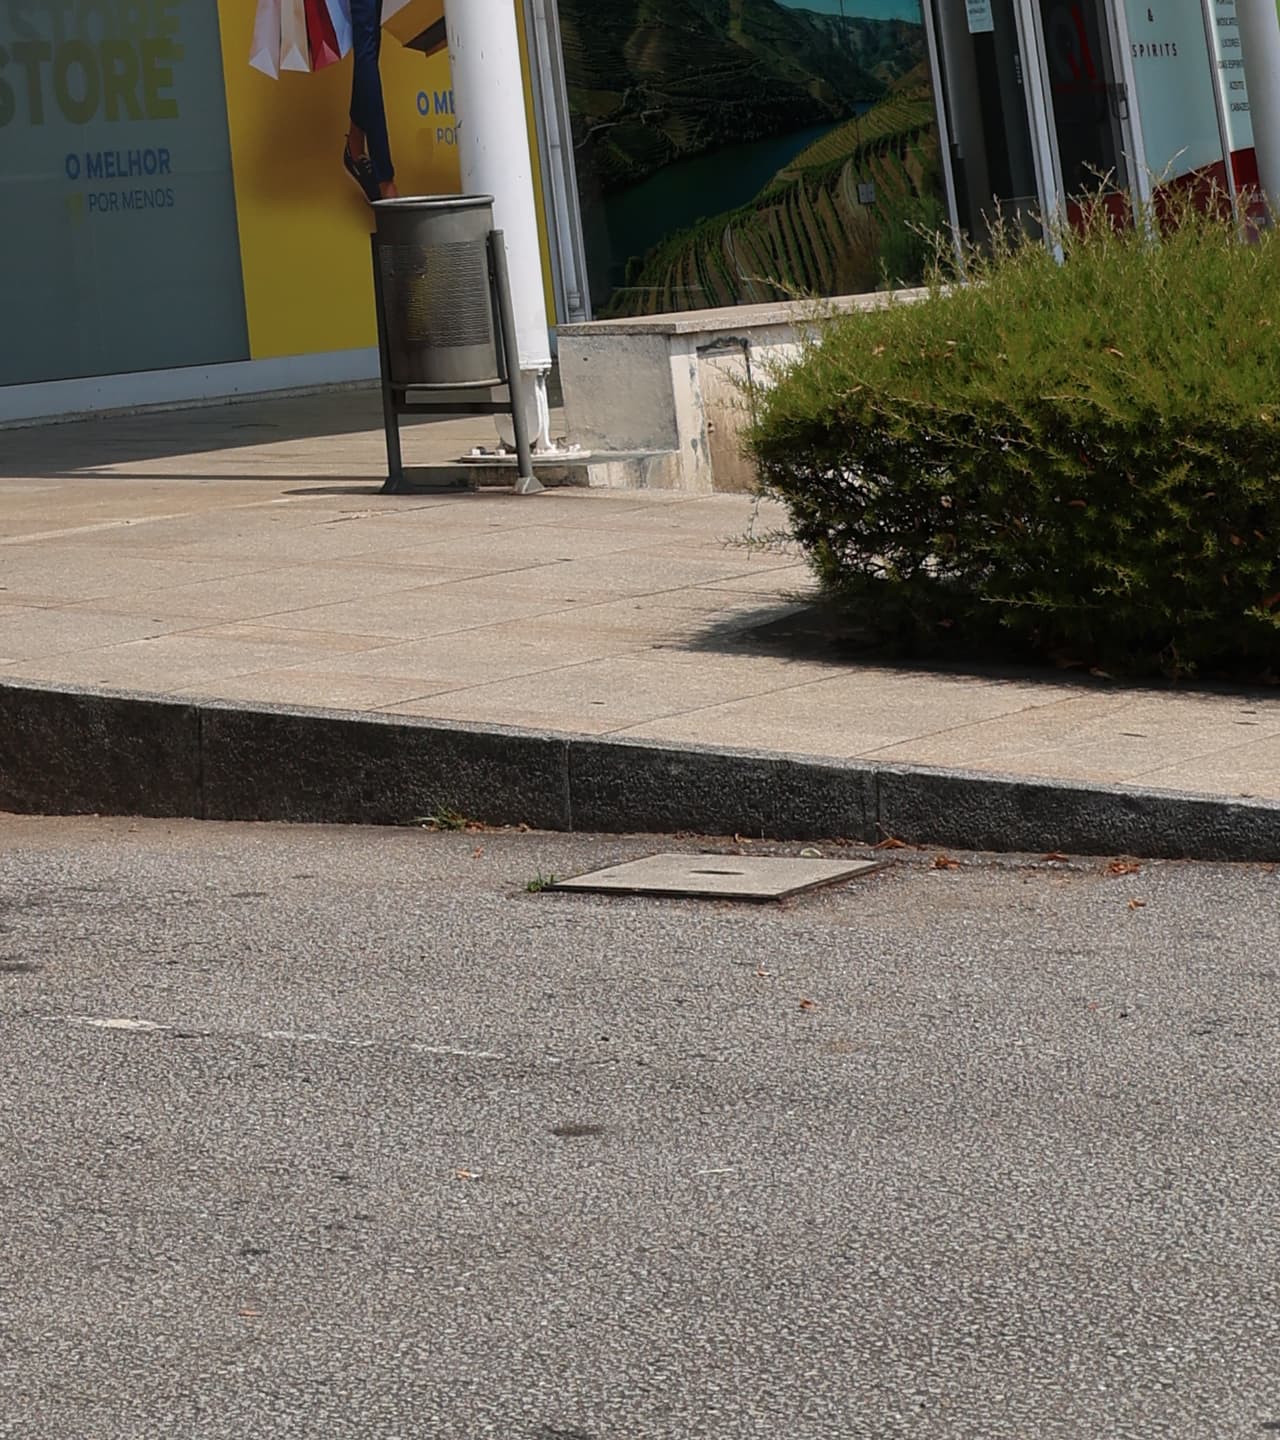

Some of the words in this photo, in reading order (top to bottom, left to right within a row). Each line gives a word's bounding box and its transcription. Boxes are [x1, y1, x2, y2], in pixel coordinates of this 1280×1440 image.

[1132, 42, 1178, 57] SPIRITS
[416, 91, 429, 116] O
[65, 153, 80, 180] O
[86, 148, 171, 179] MELHOR
[88, 192, 119, 212] POR
[122, 188, 175, 209] MENOS
